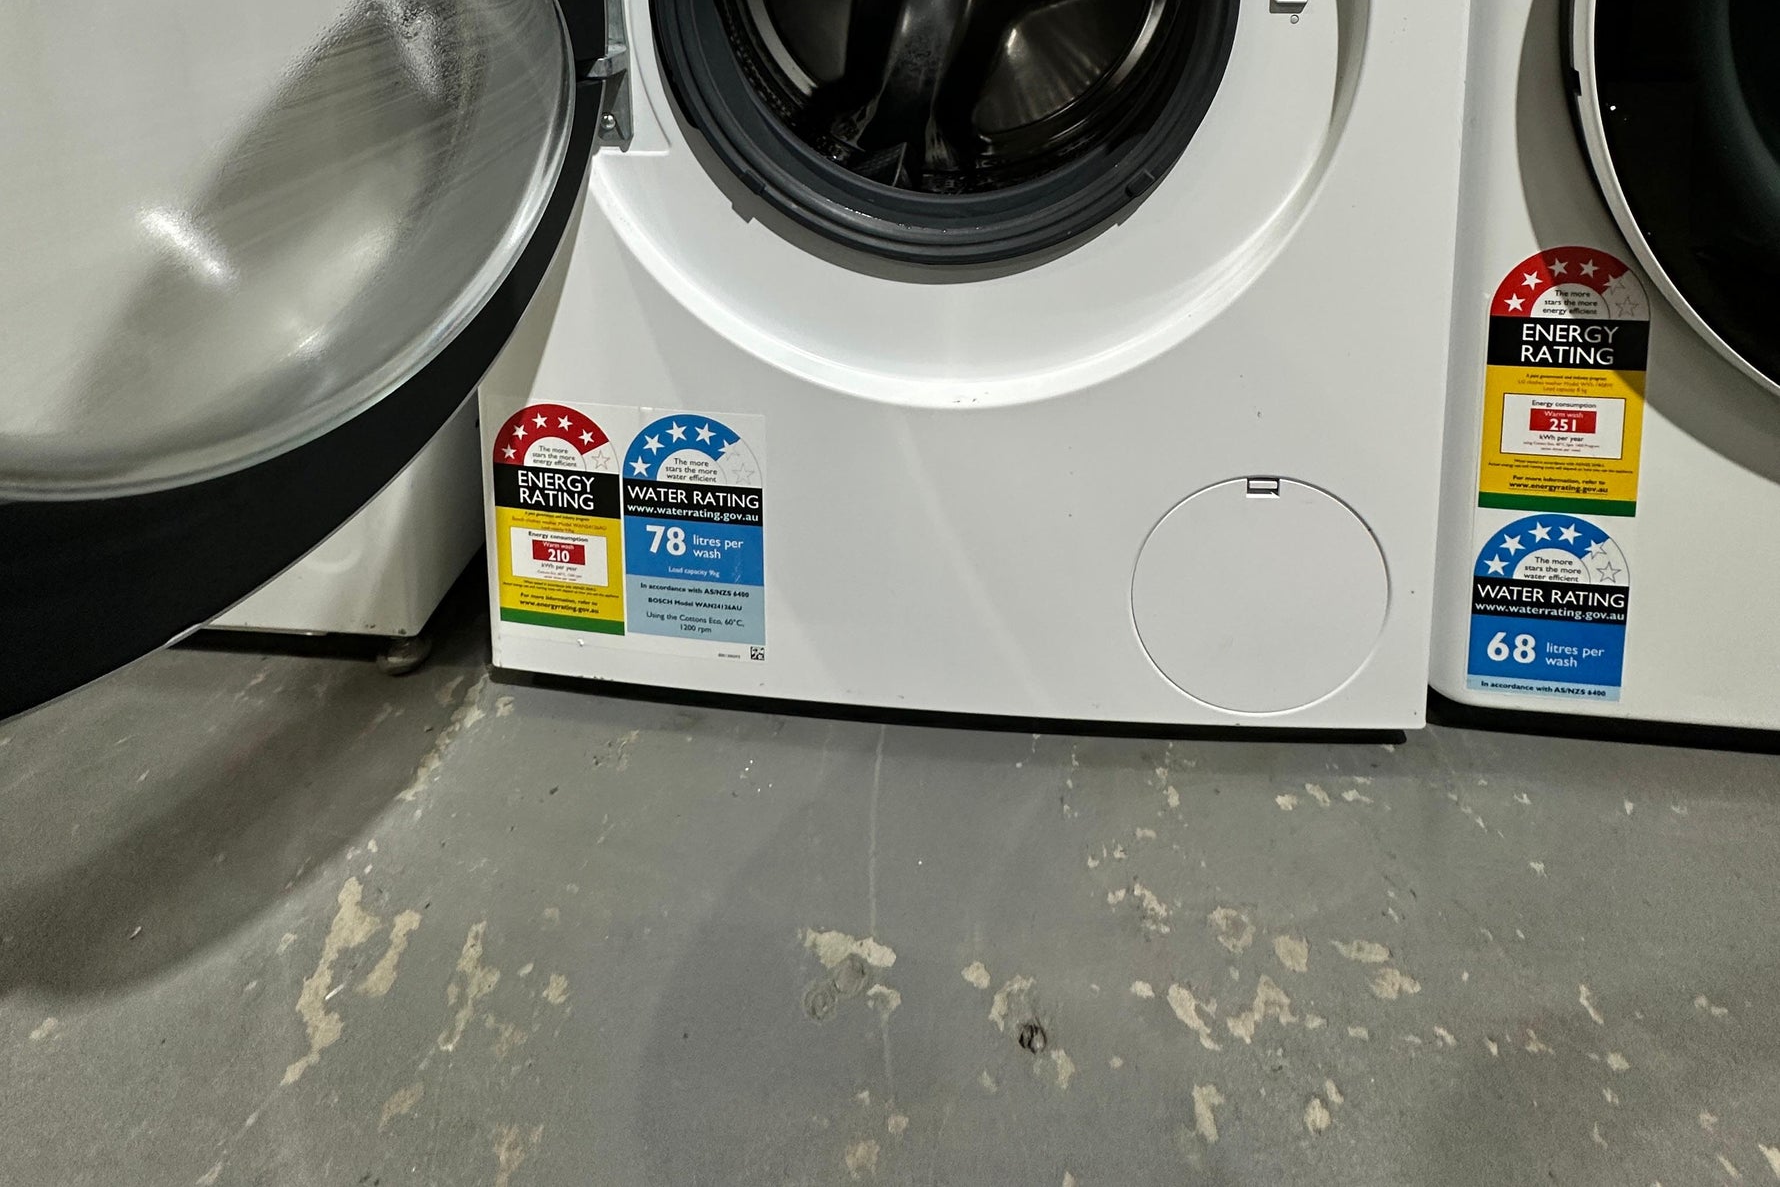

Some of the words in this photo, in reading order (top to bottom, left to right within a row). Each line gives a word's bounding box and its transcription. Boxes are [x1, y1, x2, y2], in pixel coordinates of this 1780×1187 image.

[1522, 324, 1619, 344] ENERGY
[1521, 345, 1614, 365] RATING
[1549, 418, 1577, 432] 251
[674, 458, 688, 466] The
[518, 470, 595, 493] ENERGY
[689, 475, 717, 483] efficient
[1509, 483, 1608, 493] www.energyrating.gov.au
[520, 488, 594, 510] RATING
[627, 485, 688, 504] WATER
[693, 491, 759, 509] RATING
[627, 504, 759, 522] www.waterrating.gov.au
[529, 531, 548, 539] Energy
[646, 525, 686, 556] 78
[693, 534, 721, 546] litres
[724, 540, 743, 550] per
[548, 549, 570, 562] 210
[693, 549, 721, 559] wash
[668, 566, 683, 574] Load
[684, 568, 708, 577] capacity
[1548, 574, 1579, 582] efficient
[649, 584, 686, 592] accordance
[704, 589, 731, 597] AS/NZS
[1477, 583, 1544, 603] WATER
[1551, 590, 1625, 608] RATING
[520, 600, 599, 614] www.energyrating.gov.au
[695, 602, 742, 611] WAN24126AU
[1475, 603, 1625, 621] www.waterrating.gov.au
[646, 612, 665, 621] Using
[679, 615, 707, 624] Cottons
[680, 624, 696, 632] 1200
[1487, 632, 1536, 664] 68
[1546, 642, 1578, 655] litres
[1582, 647, 1605, 658] per
[1545, 657, 1577, 668] wash
[1490, 682, 1533, 691] accordance
[1536, 685, 1552, 693] with
[1554, 687, 1585, 695] AS/NZS
